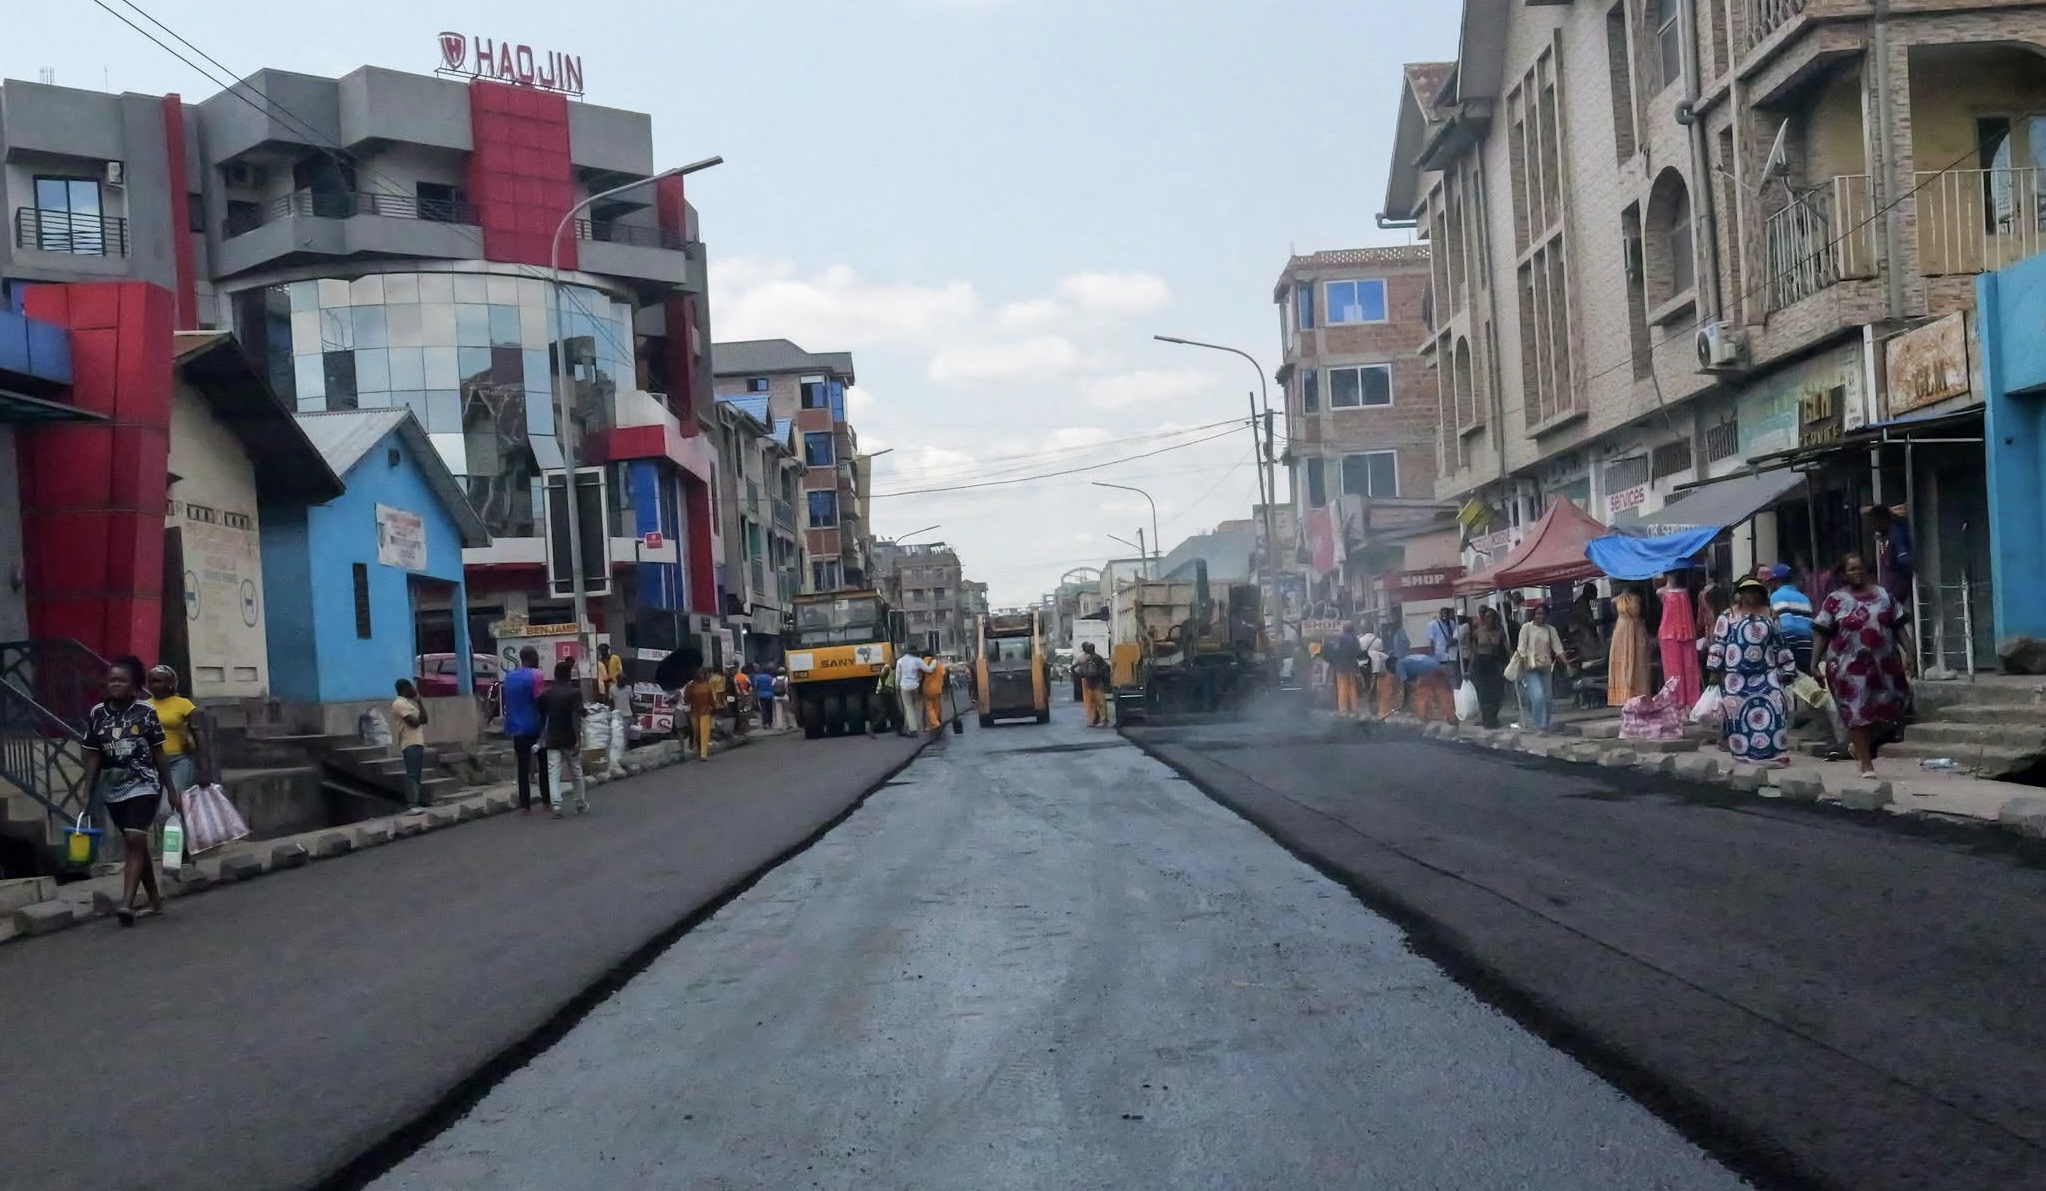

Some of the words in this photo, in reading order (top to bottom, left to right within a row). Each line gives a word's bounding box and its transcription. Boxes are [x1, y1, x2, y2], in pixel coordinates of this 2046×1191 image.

[475, 36, 583, 91] HAOJIN
[1401, 573, 1445, 587] SHOP
[1303, 621, 1341, 629] SHOP
[821, 658, 856, 669] SANY
